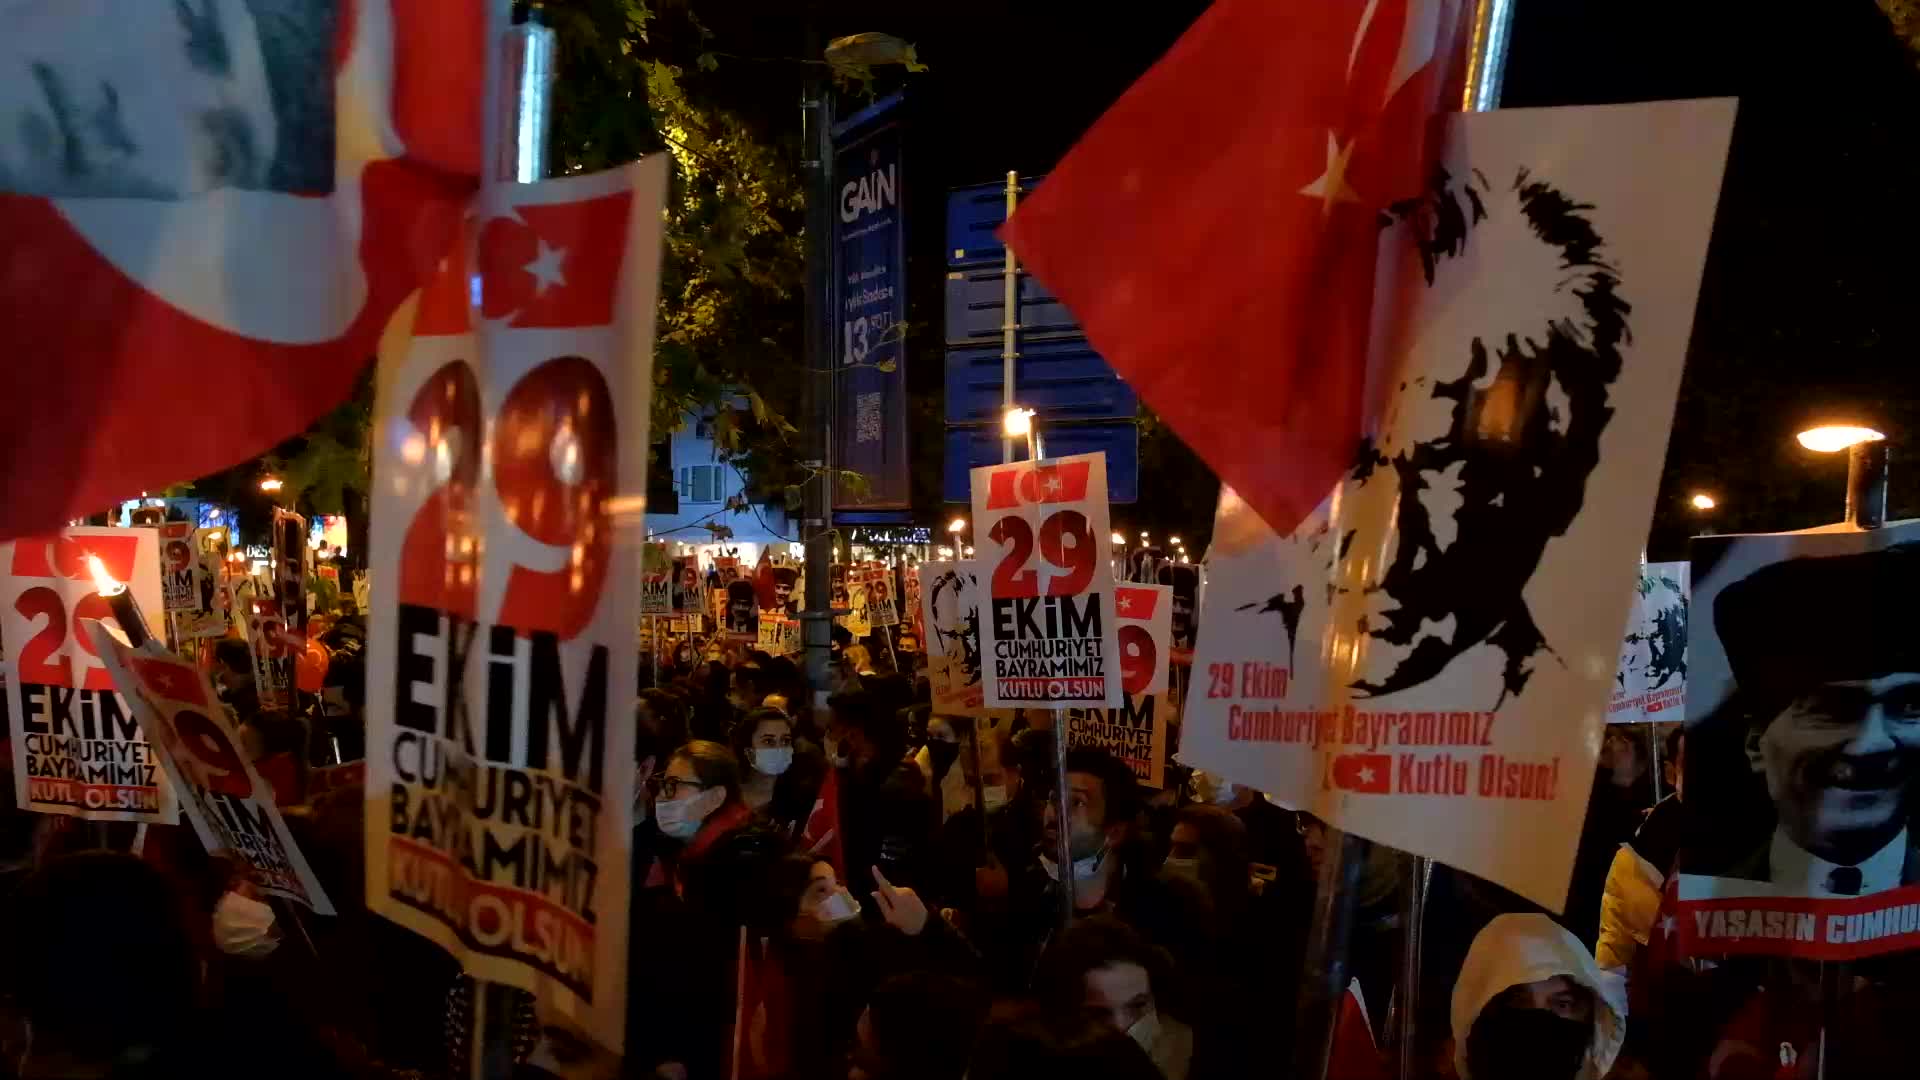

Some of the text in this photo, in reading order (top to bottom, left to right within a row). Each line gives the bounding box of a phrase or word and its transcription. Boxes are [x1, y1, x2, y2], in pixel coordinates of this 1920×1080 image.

[397, 355, 617, 641] 29
[988, 509, 1097, 600] 29
[995, 656, 1105, 679] BAYRAMIMIZ
[1117, 624, 1157, 696] 9
[1207, 660, 1289, 699] 29 Ekim
[999, 679, 1044, 699] KUTLU
[1047, 680, 1105, 700] OLSUN
[26, 755, 158, 787] BAYRAMIMIZ
[31, 782, 82, 803] KUTL
[1398, 754, 1561, 801] Kutlu Olsun!
[390, 853, 464, 928] KUT
